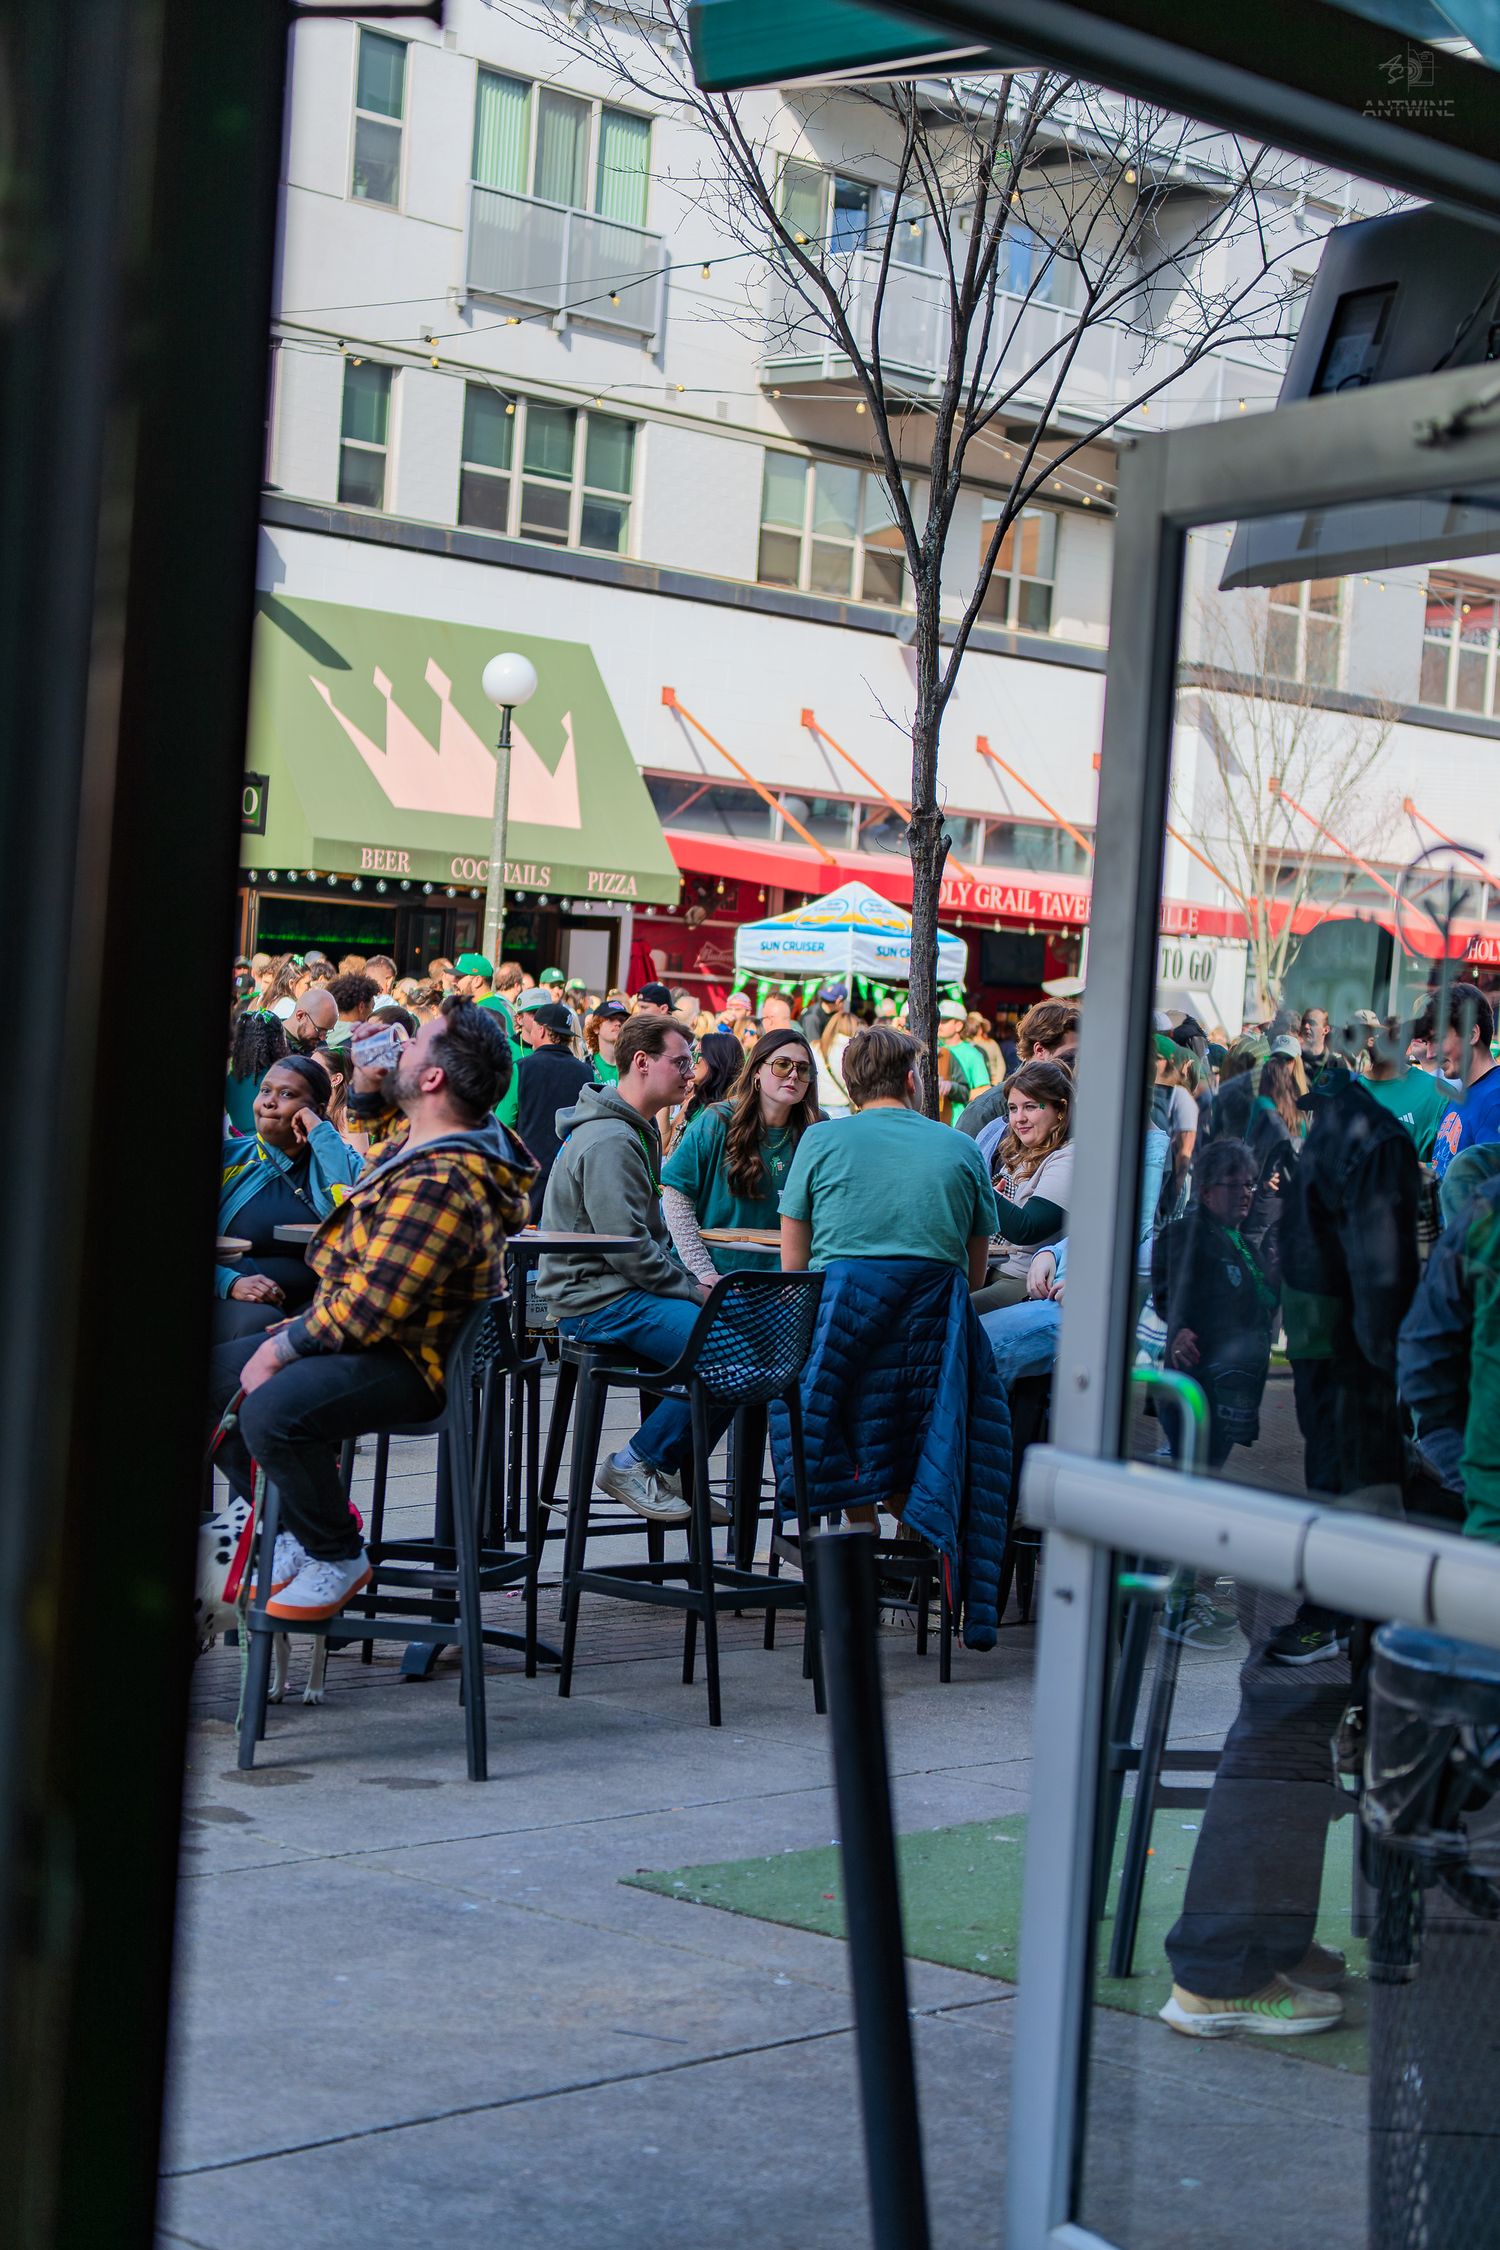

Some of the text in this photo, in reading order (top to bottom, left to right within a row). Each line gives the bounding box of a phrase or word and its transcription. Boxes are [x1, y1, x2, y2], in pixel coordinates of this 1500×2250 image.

[360, 847, 638, 896] BEER COCTAILS PIZZA
[938, 881, 972, 908] OLY
[974, 885, 1036, 914] GRAIL
[760, 940, 825, 952] SUN CRUISER
[876, 946, 897, 957] SUN
[1161, 947, 1213, 982] TO GO
